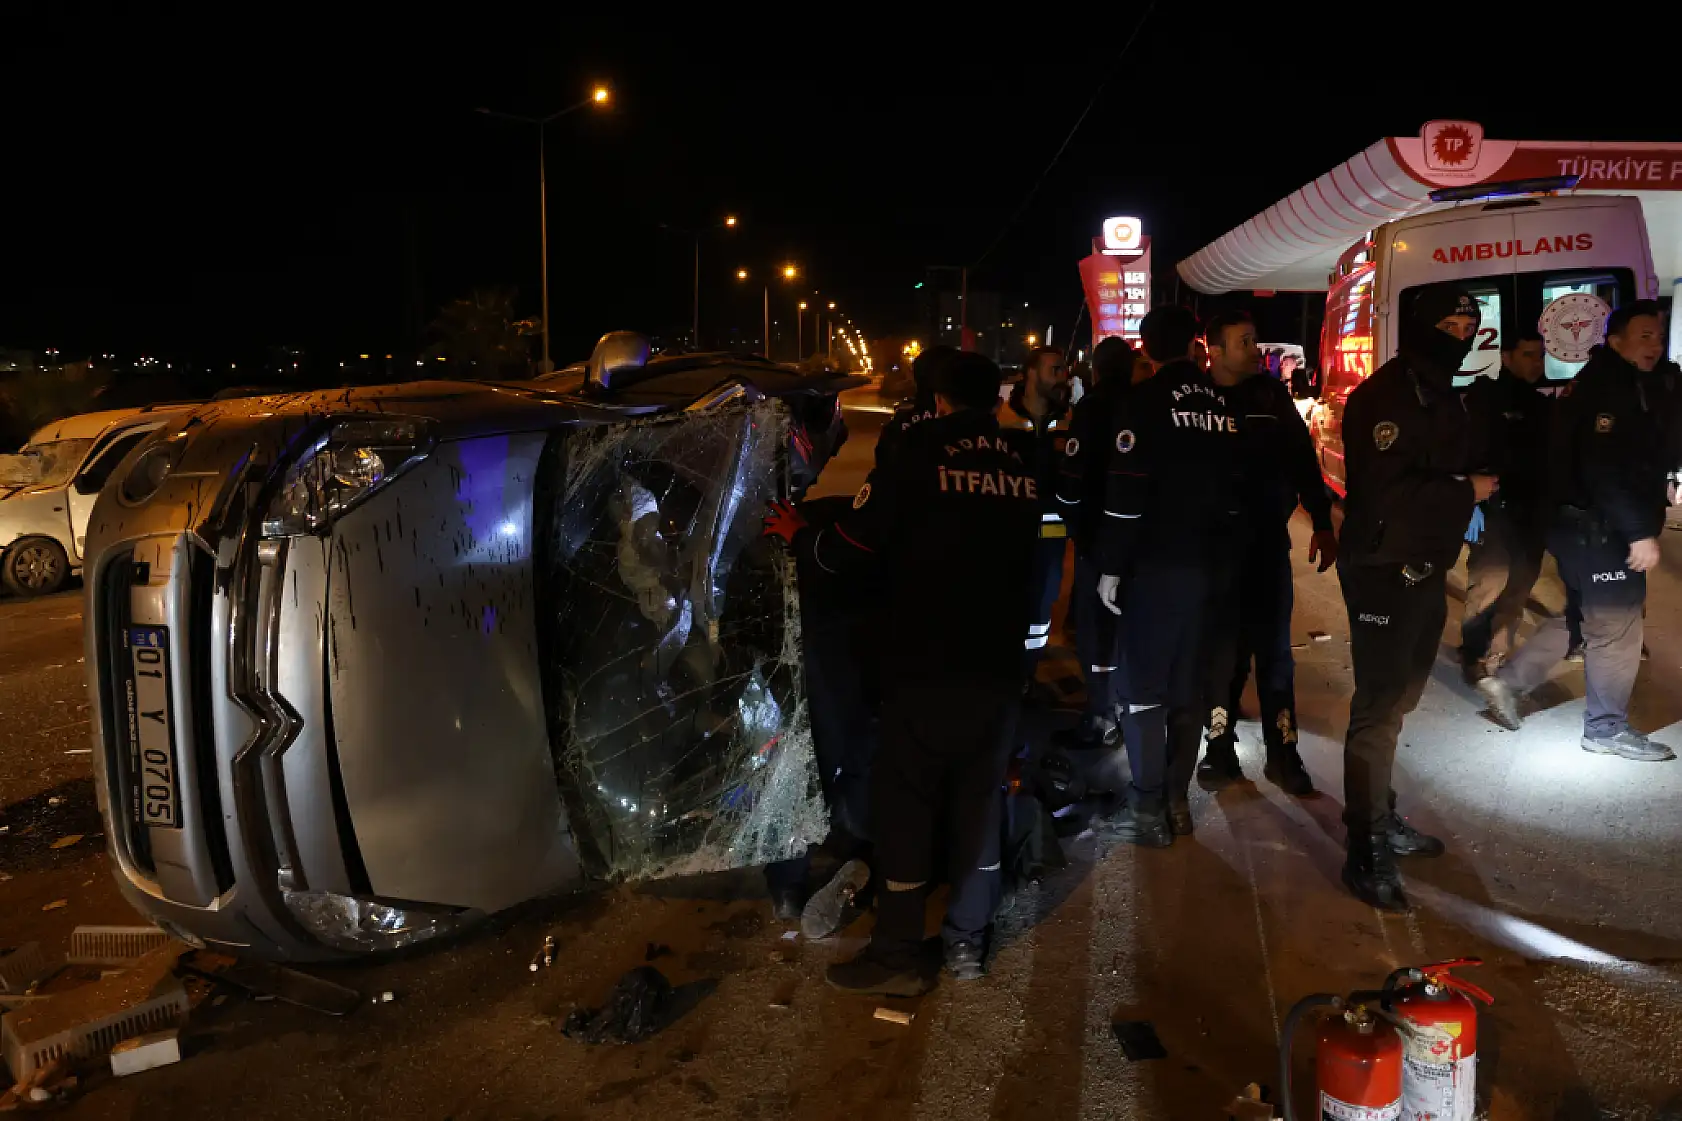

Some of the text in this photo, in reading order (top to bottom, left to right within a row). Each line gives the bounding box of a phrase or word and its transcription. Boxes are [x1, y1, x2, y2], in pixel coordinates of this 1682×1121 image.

[1444, 138, 1464, 151] TP
[1557, 155, 1663, 181] TÜRKİYE
[1432, 232, 1593, 264] AMBULANS
[945, 435, 1023, 465] ADANA
[938, 465, 1038, 500] İTFAİYE
[137, 648, 171, 820] 01 Y 0705
